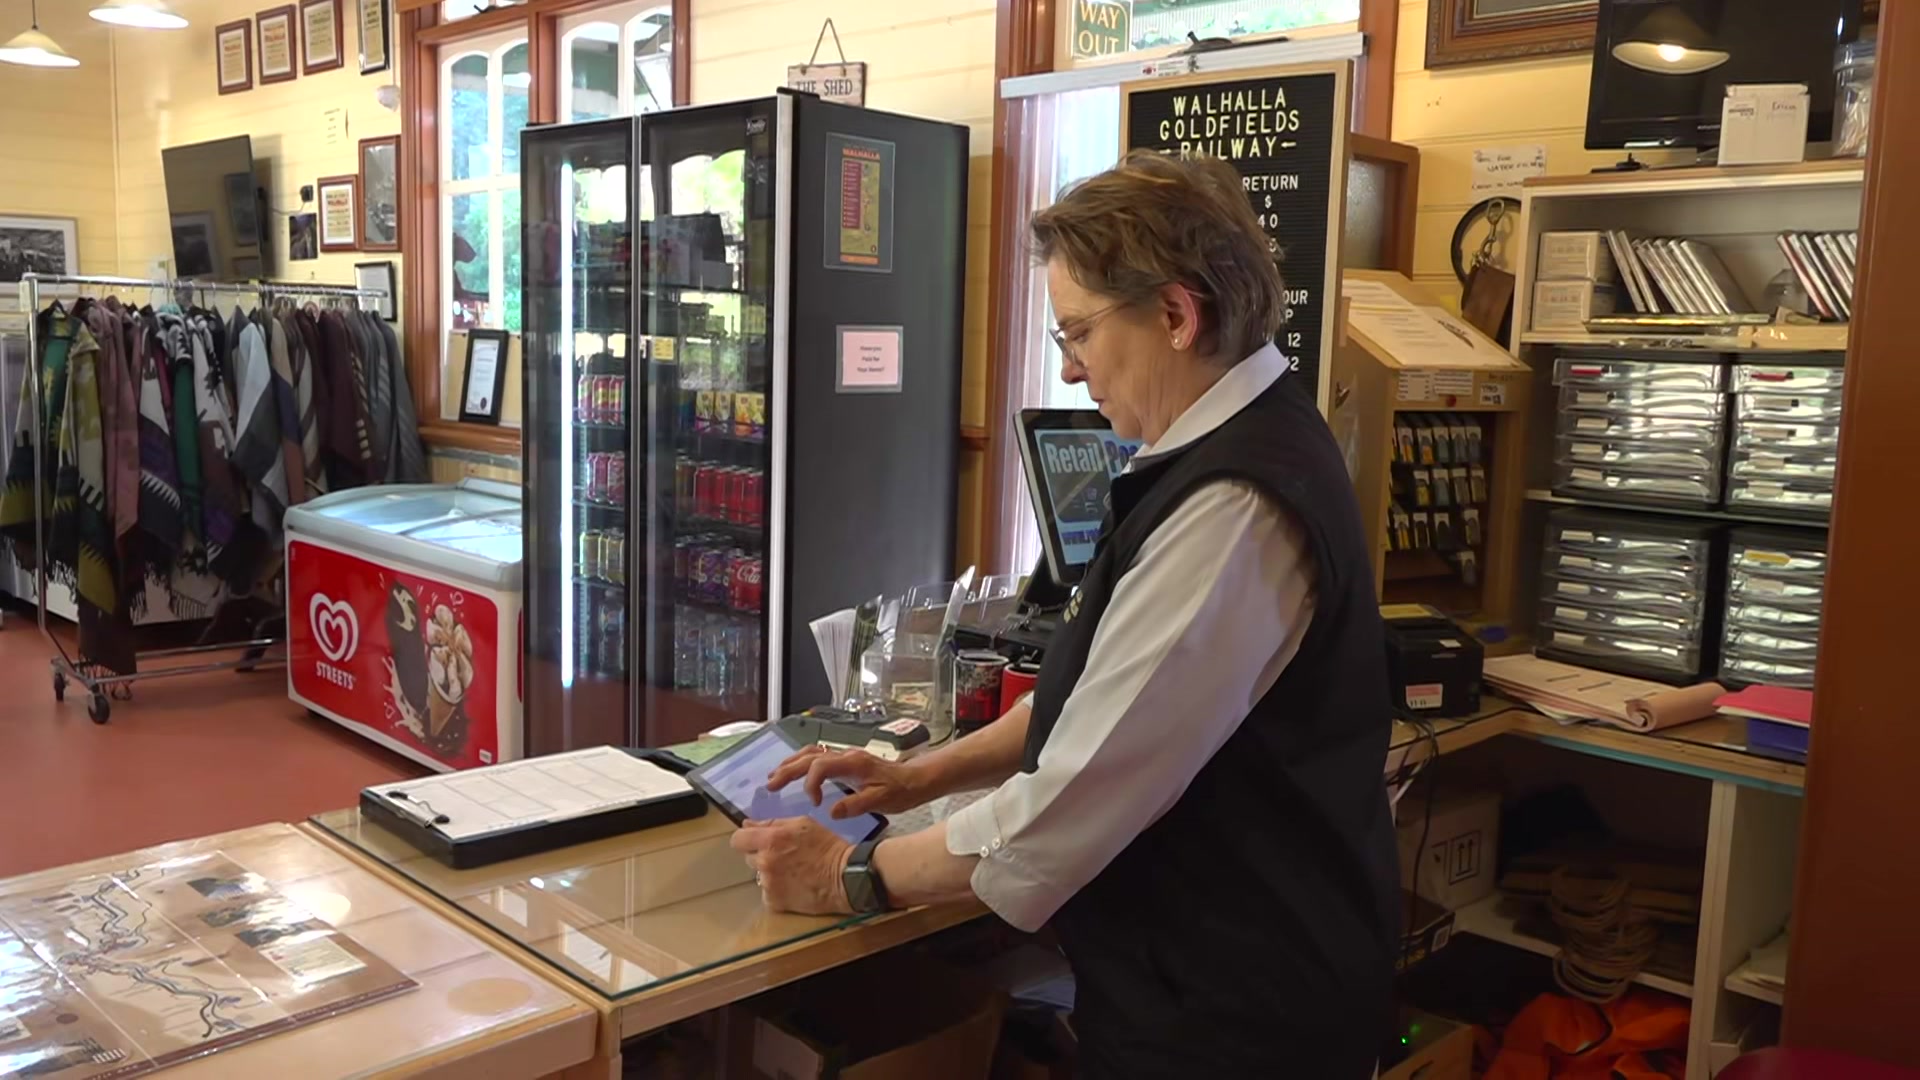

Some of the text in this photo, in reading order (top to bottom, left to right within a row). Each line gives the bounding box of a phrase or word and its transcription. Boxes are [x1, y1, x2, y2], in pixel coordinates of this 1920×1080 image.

[1079, 2, 1120, 29] WAY
[1078, 30, 1119, 55] OUT
[796, 79, 853, 96] THE SHED
[1173, 87, 1286, 116] WALHALLA
[1159, 110, 1300, 141] GOLDFIELDS
[1180, 136, 1277, 162] RAILWAY
[1242, 174, 1299, 191] RETURN
[1257, 213, 1278, 229] 40
[1287, 332, 1301, 348] 12
[1044, 441, 1103, 474] Retail
[315, 660, 354, 690] STREETS
